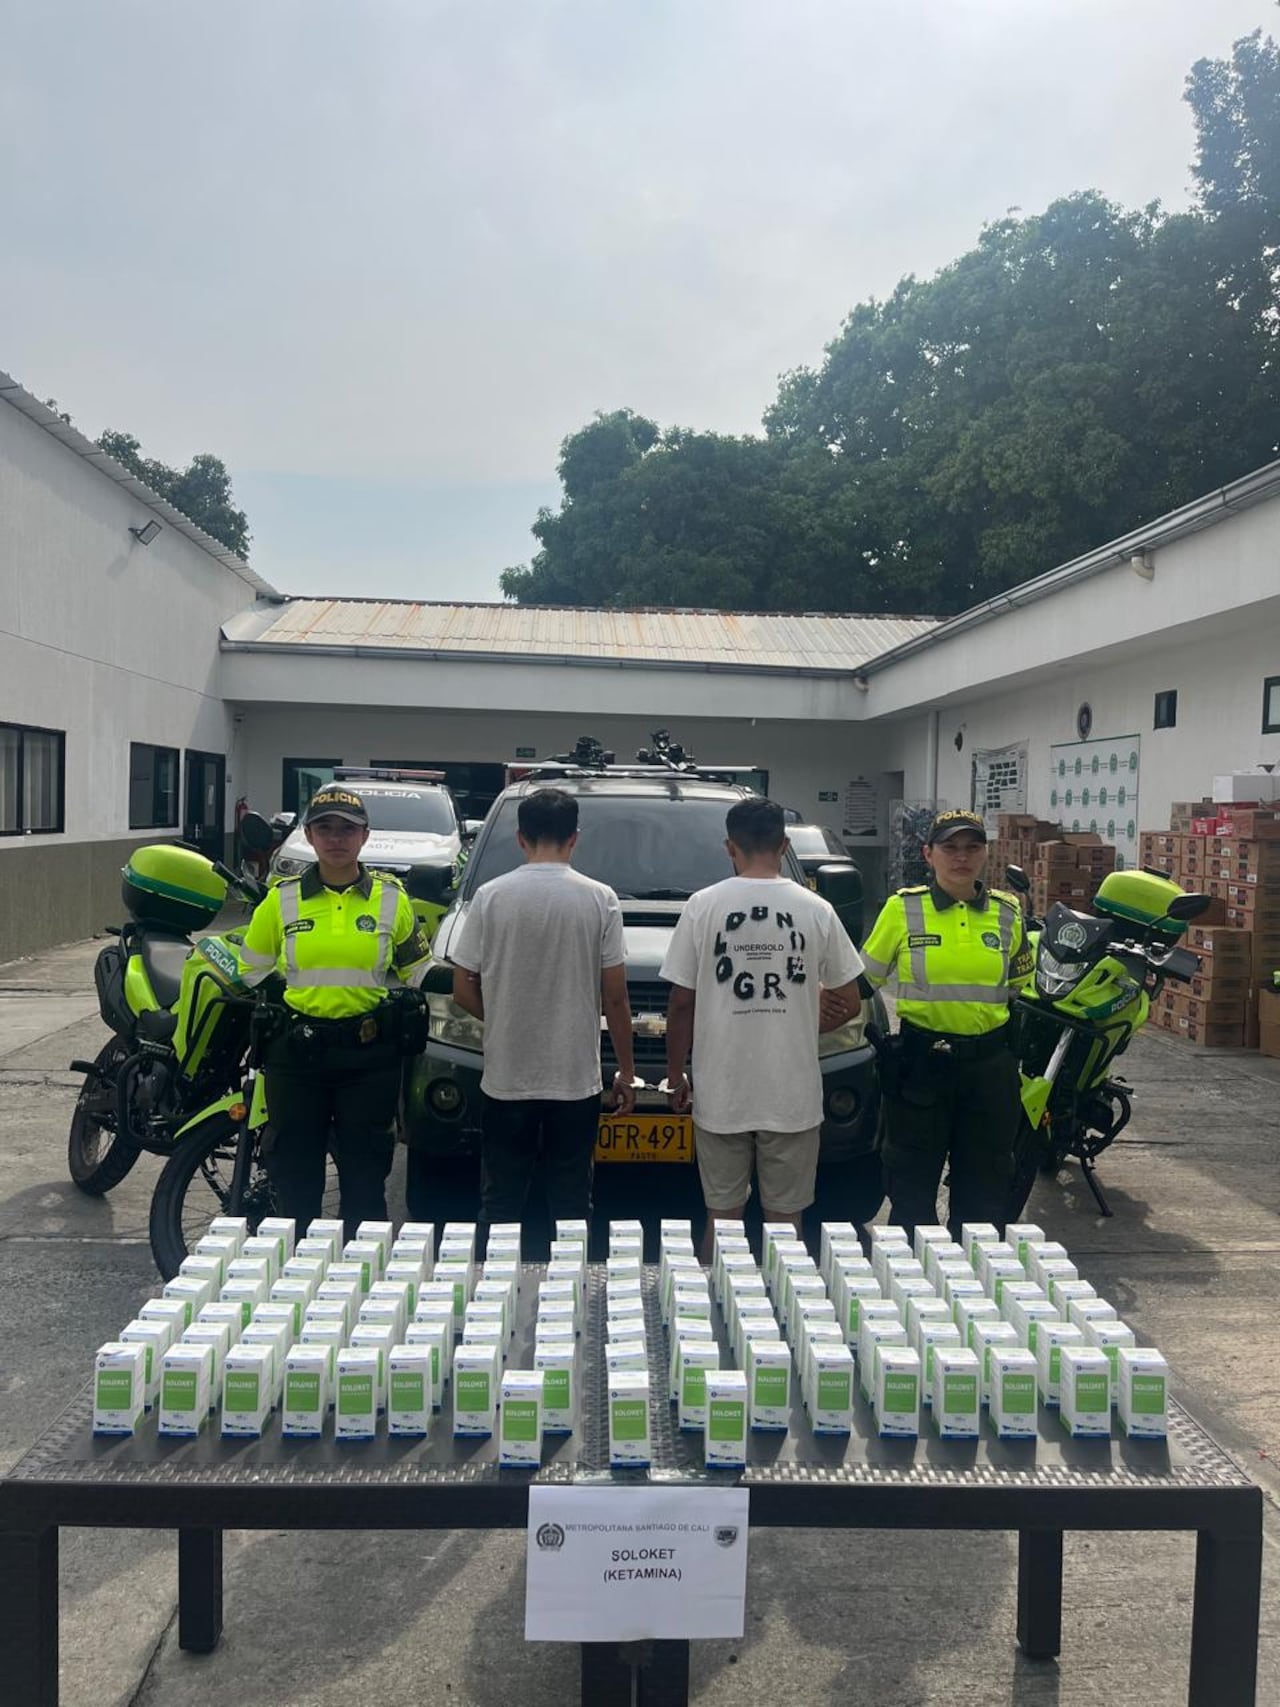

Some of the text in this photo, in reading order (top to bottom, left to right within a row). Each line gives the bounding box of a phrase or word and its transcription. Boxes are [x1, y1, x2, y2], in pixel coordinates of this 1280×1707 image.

[733, 943, 784, 951] UNDERGOLD
[565, 1523, 710, 1532] METROPOLITANA SANTIAGO DE CALI
[611, 1548, 676, 1562] SOLOKET
[603, 1568, 682, 1583] (KETAMINA)
